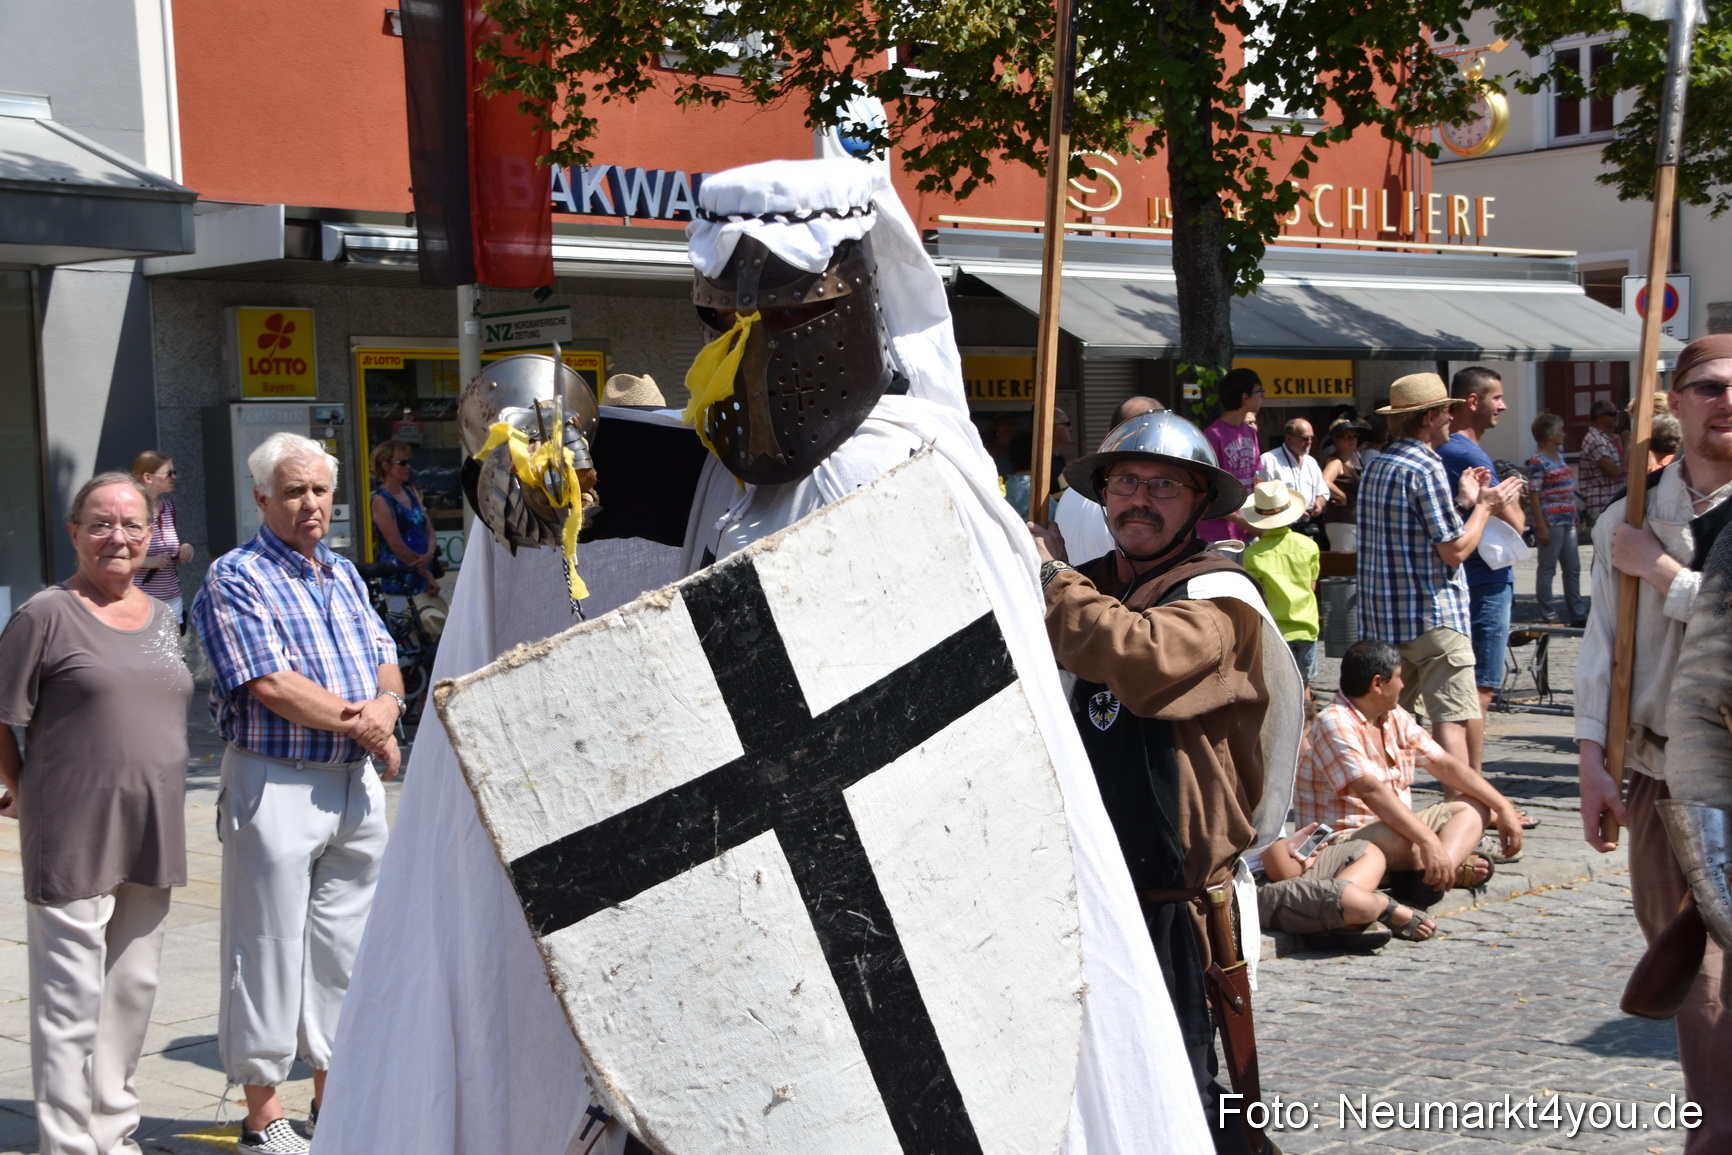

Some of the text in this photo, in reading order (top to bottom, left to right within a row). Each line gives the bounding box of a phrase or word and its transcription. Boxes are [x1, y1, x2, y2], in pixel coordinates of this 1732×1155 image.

[486, 316, 567, 343] NZ NORDBAYERISCHE
[515, 329, 541, 340] ZEITUNG
[248, 356, 307, 376] LOTTO
[373, 356, 401, 366] LOTTO
[574, 358, 598, 367] LOTTO
[262, 381, 295, 393] Bayern
[1274, 378, 1353, 394] SCHLIERF
